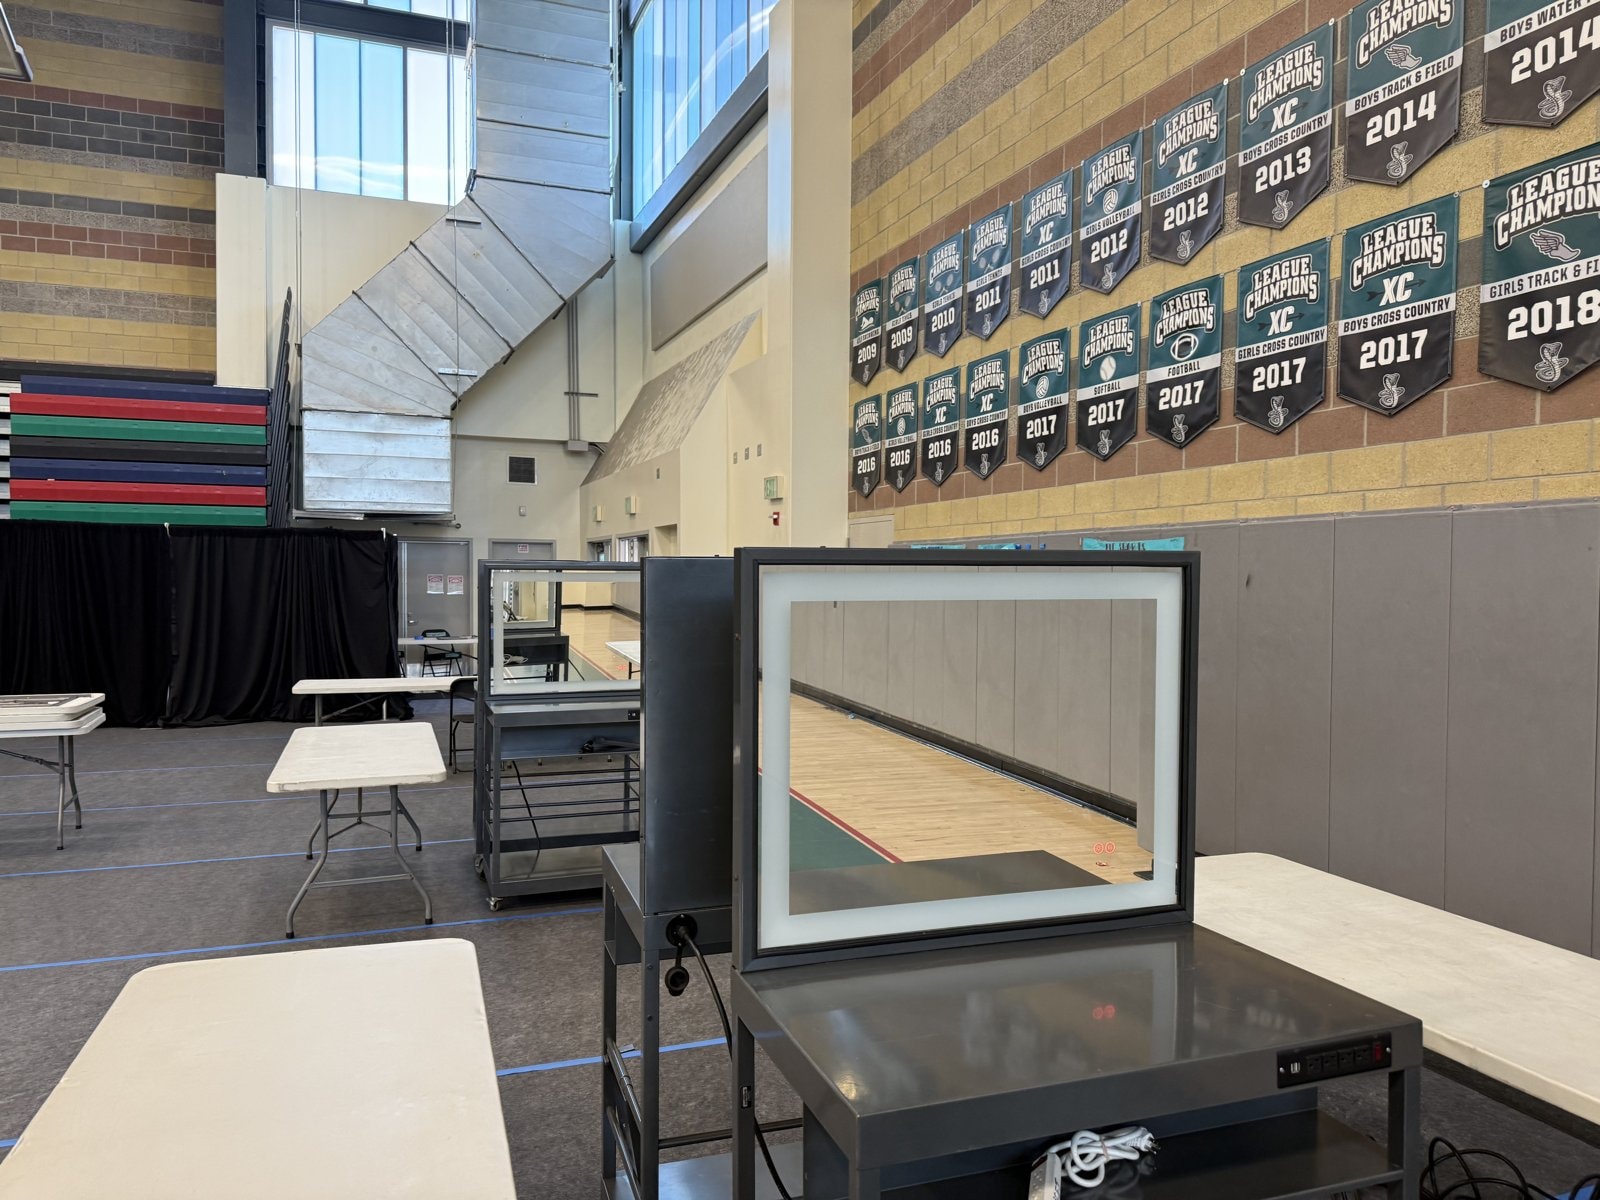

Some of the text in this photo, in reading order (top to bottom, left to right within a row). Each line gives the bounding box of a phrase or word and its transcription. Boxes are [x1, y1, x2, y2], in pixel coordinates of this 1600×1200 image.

[1359, 0, 1451, 65] CHAMPIONS
[1500, 17, 1533, 43] BOYS
[1510, 14, 1600, 85] 2014
[1257, 44, 1315, 88] LEAGUE
[1249, 60, 1323, 121] CHAMPIONS
[1354, 55, 1454, 111] BOYS TRACK & FIELD
[1165, 101, 1212, 138] LEAGUE
[1270, 98, 1298, 133] XC
[1366, 90, 1437, 147] 2014
[1159, 115, 1218, 166] CHAMPIONS
[1243, 113, 1328, 163] BOYS CROSS COUNTRY
[1092, 146, 1130, 177] LEAGUE
[1176, 148, 1198, 179] XC
[1255, 145, 1312, 194] 2013
[1031, 183, 1063, 211] LEAGUE
[1087, 159, 1135, 204] CHAMPIONS
[1152, 163, 1224, 203] GIRLS CROSS COUNTRY
[1510, 160, 1600, 209] LEAGUE
[1026, 195, 1067, 236] CHAMPIONS
[1086, 206, 1135, 236] GIRLS VOLLEYBALL
[1163, 192, 1209, 232] 2012
[1497, 184, 1600, 246] CHAMPION
[973, 228, 1007, 261] CHAMPIONS
[976, 216, 1004, 242] LEAGUE
[1038, 221, 1054, 246] XC
[1362, 215, 1433, 255] LEAGUE
[933, 243, 956, 266] LEAGUE
[1091, 228, 1128, 263] 2012
[892, 267, 913, 286] LEAGUE
[930, 254, 959, 285] CHAMPIONS
[1030, 259, 1060, 290] 2011
[1253, 256, 1310, 291] LEAGUE
[1352, 235, 1444, 288] CHAMPIONS
[890, 277, 916, 304] CHAMPIONS
[1246, 273, 1318, 320] CHAMPIONS
[1379, 271, 1415, 307] XC
[1489, 279, 1524, 298] GIRLS
[1527, 267, 1568, 289] TRACK
[1573, 264, 1581, 278] &
[975, 286, 1001, 313] 2011
[1162, 289, 1208, 320] LEAGUE
[1343, 297, 1451, 333] BOYS CROSS COUNTRY
[1507, 288, 1600, 341] 2018
[931, 307, 955, 333] 2010
[1090, 316, 1128, 341] LEAGUE
[1156, 305, 1214, 345] CHAMPIONS
[1267, 305, 1295, 337] XC
[857, 342, 877, 364] 2009
[891, 326, 913, 349] 2009
[1027, 341, 1060, 363] LEAGUE
[1084, 331, 1133, 366] CHAMPIONS
[1238, 328, 1325, 360] GIRLS CROSS COUNTRY
[1360, 328, 1428, 370] 2017
[974, 361, 1001, 380] LEAGUE
[1023, 353, 1064, 384] CHAMPIONS
[1167, 360, 1201, 377] FOOTBALL
[1252, 356, 1307, 393] 2017
[892, 390, 912, 407] LEAGUE
[926, 388, 956, 412] CHAMPIONS
[930, 376, 953, 393] LEAGUE
[970, 373, 1005, 399] CHAMPIONS
[1093, 381, 1121, 396] SOFTBALL
[1158, 379, 1205, 411] 2017
[889, 402, 915, 423] CHAMPIONS
[934, 406, 947, 424] XC
[980, 393, 994, 412] XC
[1023, 396, 1063, 414] BOYS VOLLEYBALL
[1088, 398, 1125, 426] 2017
[855, 412, 879, 433] CHAMPIONS
[1026, 414, 1057, 439] 2017
[928, 439, 952, 459] 2016
[972, 428, 999, 451] 2016
[857, 457, 876, 475] 2016
[890, 449, 911, 467] 2016
